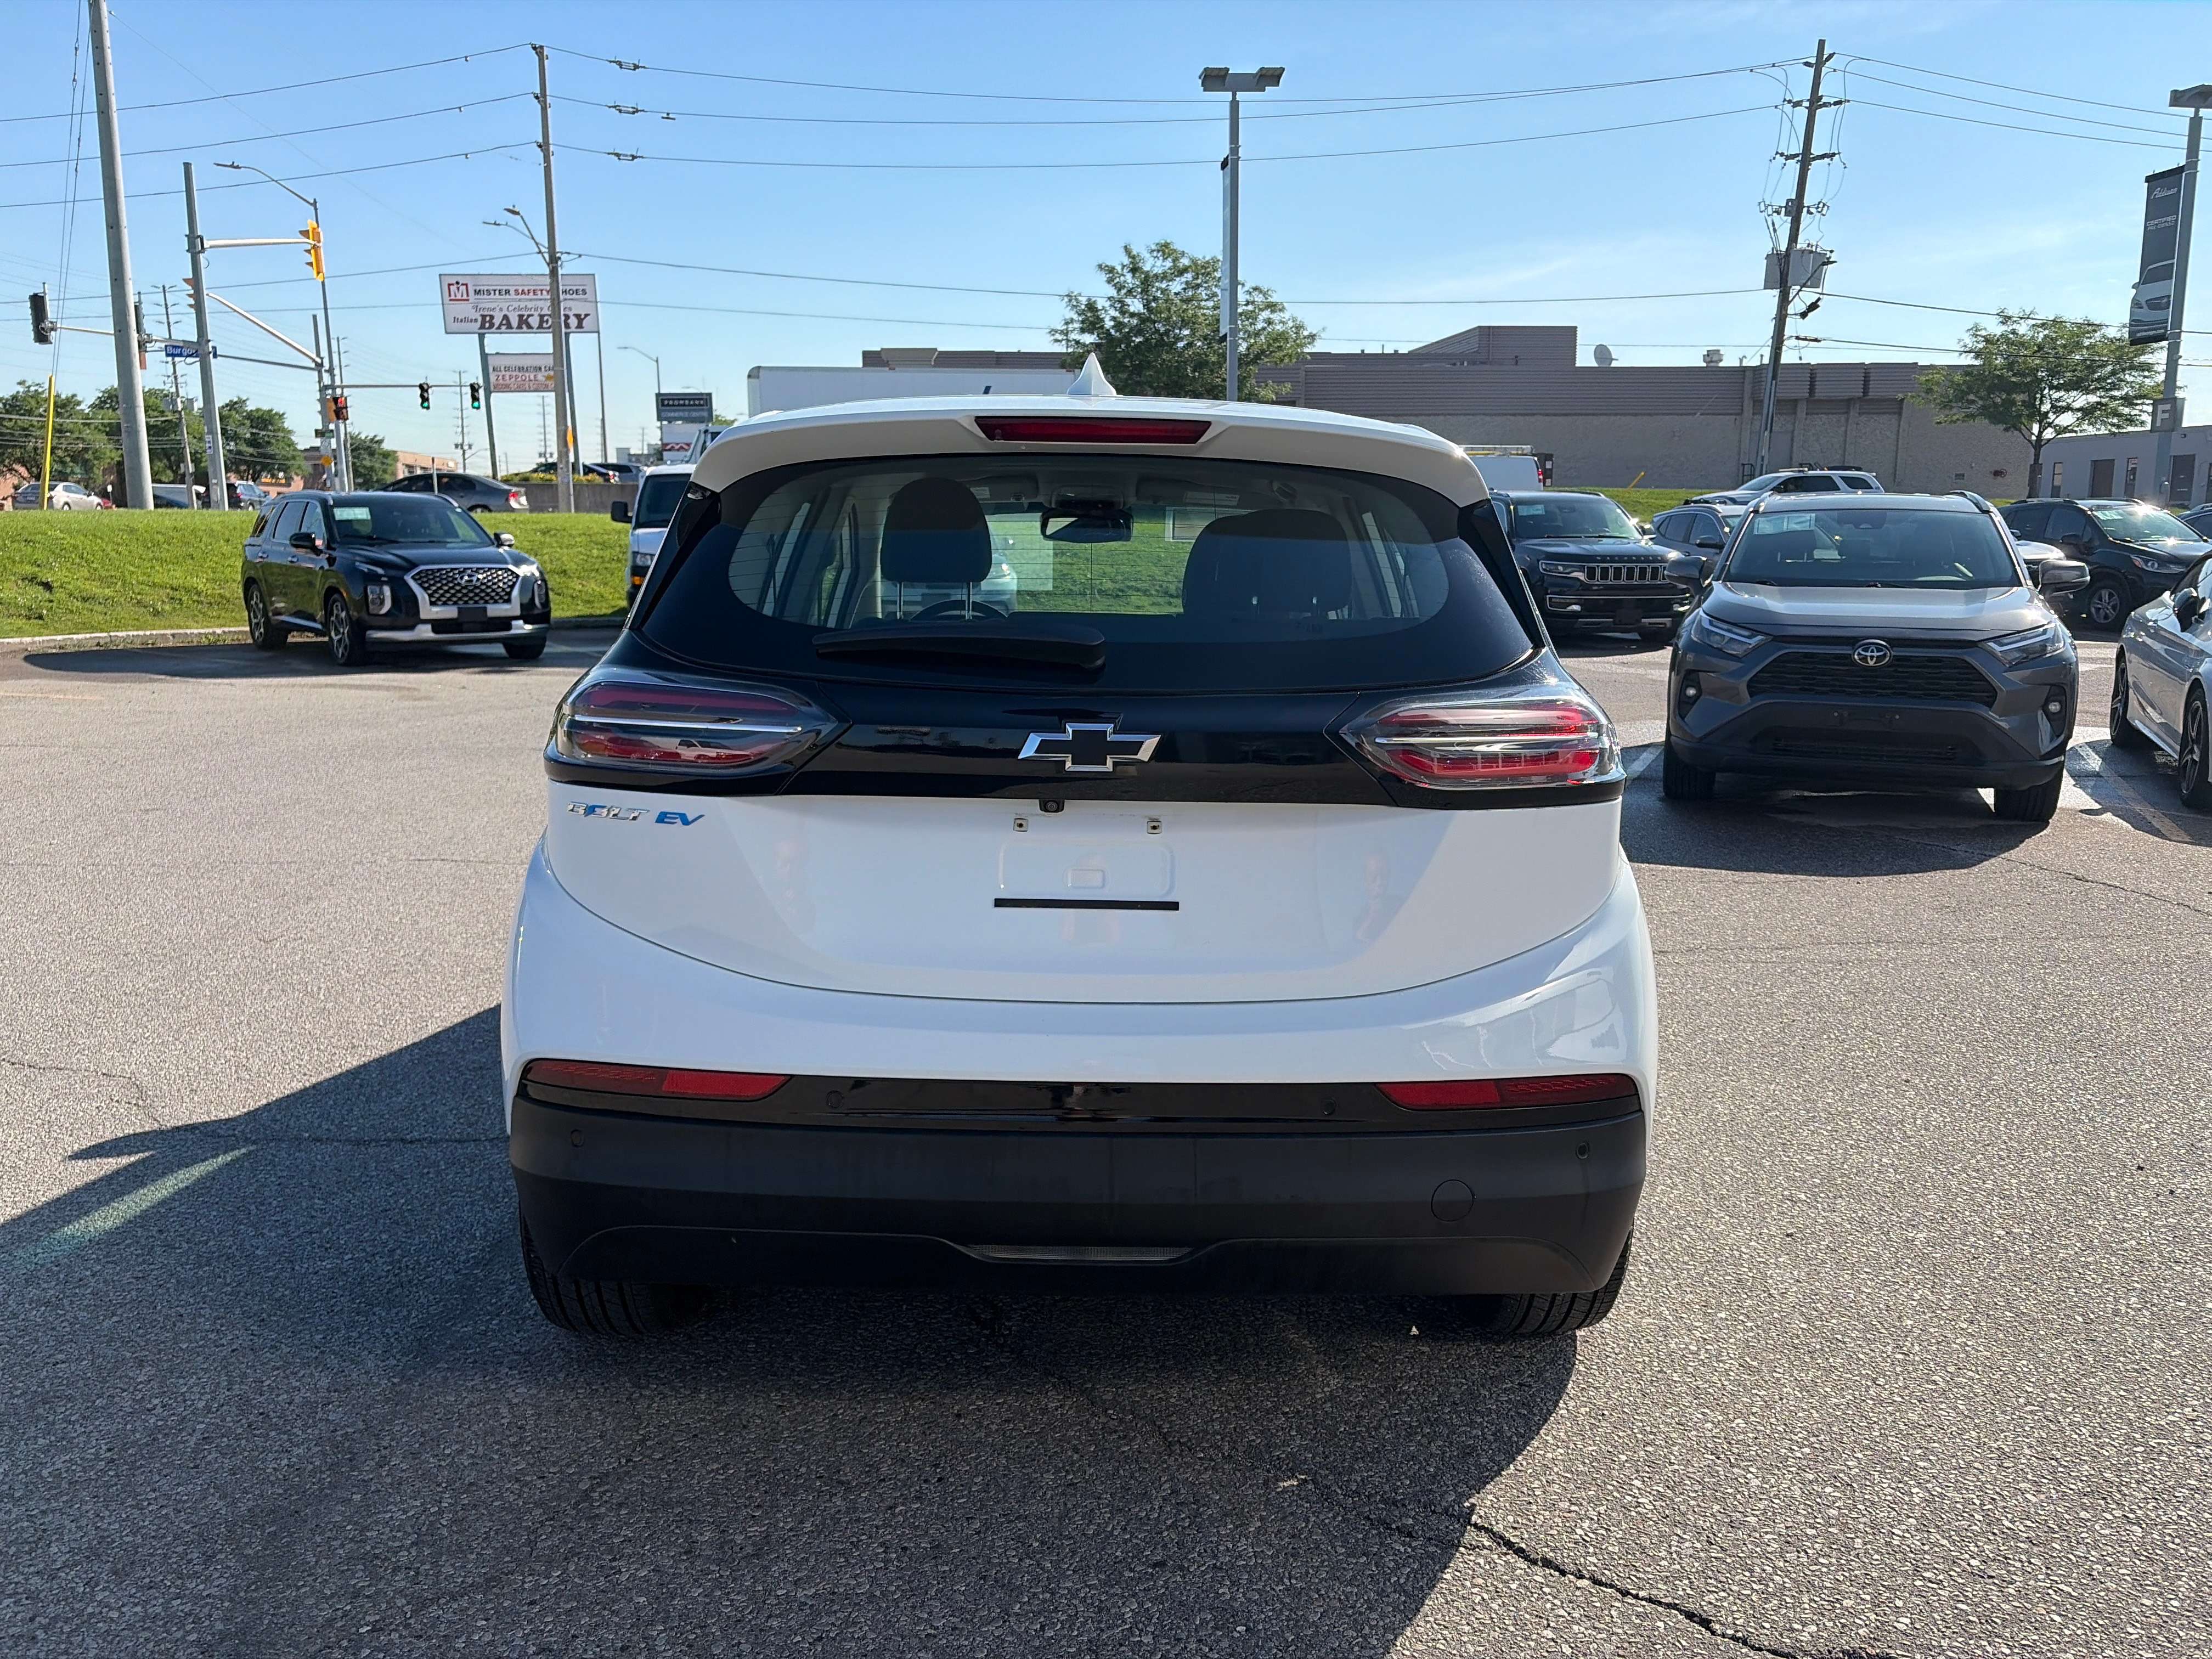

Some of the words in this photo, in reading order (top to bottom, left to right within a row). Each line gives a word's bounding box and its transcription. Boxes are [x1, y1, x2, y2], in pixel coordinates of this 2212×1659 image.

[2146, 215, 2177, 226] CERTIFIED
[506, 304, 544, 313] Celebrity
[2156, 404, 2171, 427] F
[567, 801, 650, 821] BOLT
[655, 811, 705, 826] EV
